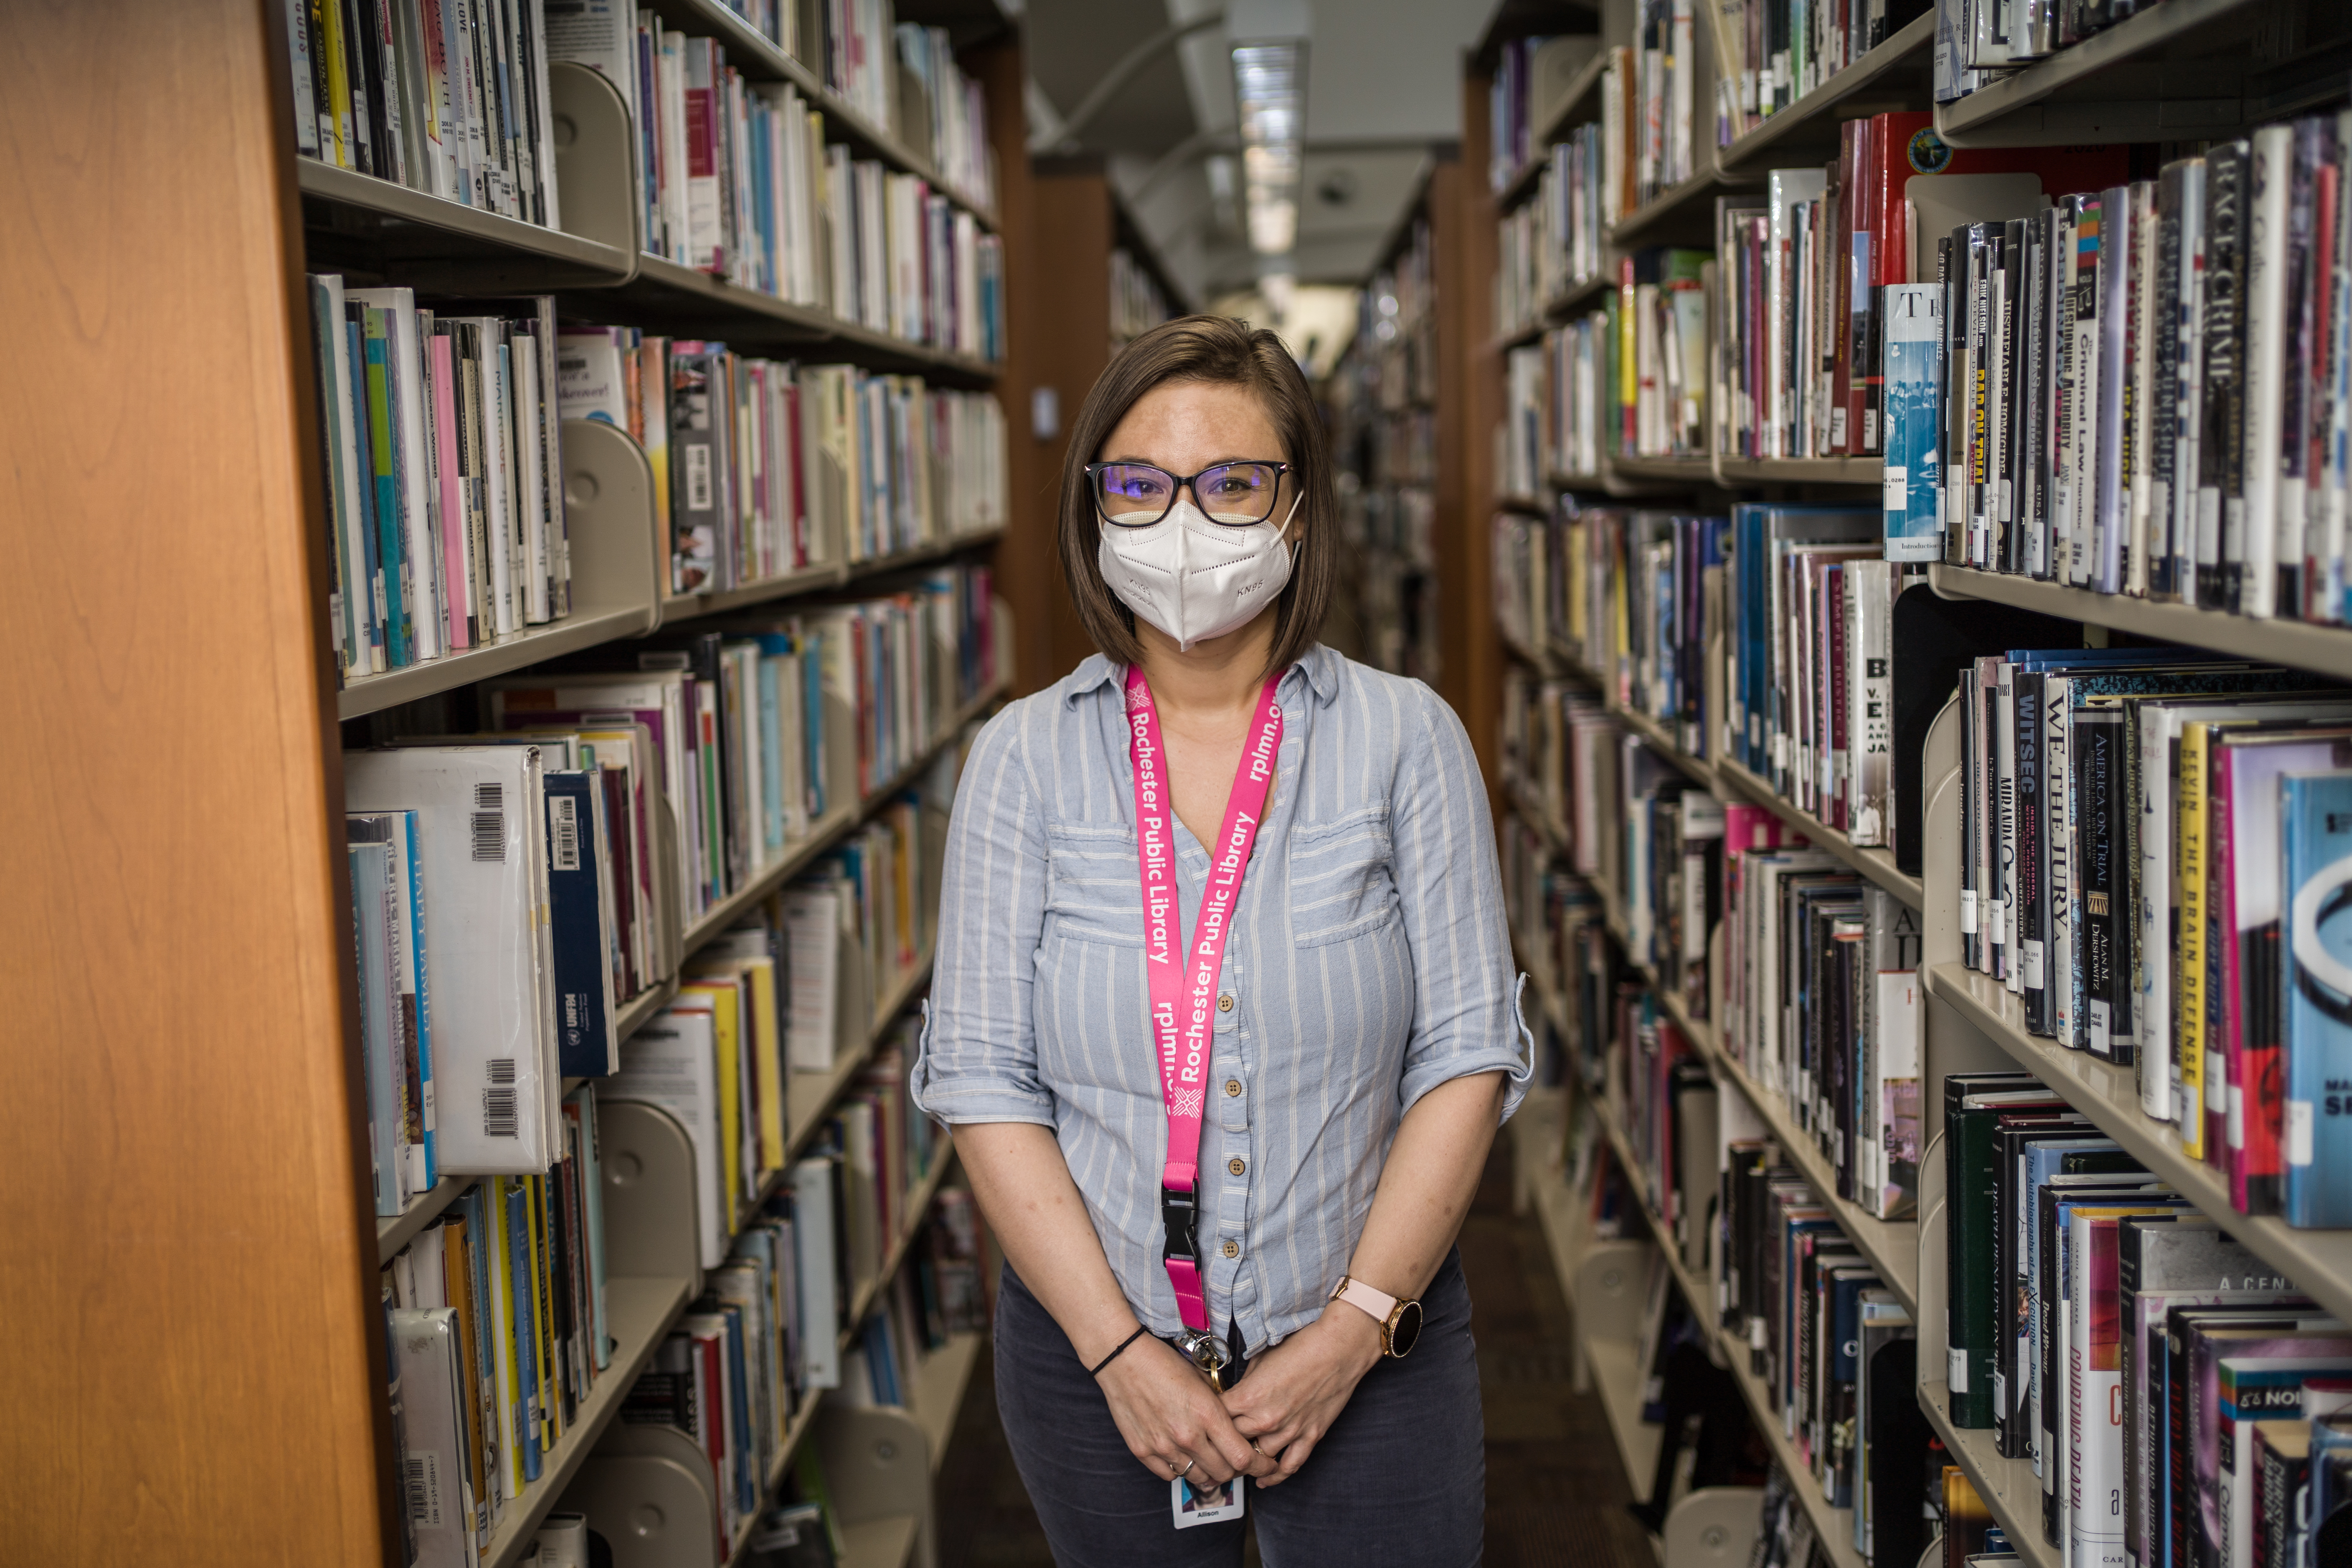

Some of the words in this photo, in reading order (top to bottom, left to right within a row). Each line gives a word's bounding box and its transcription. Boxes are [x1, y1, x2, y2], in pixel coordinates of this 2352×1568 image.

[458, 2, 467, 34] LOVE
[1938, 252, 1945, 263] 40
[2166, 218, 2179, 299] CRIME
[1978, 299, 1987, 333] NIELSON
[1979, 279, 1987, 297] ERIK
[2056, 241, 2066, 389] ORDINARY
[1937, 313, 1944, 327] 40
[2001, 299, 2011, 396] JUSTIFIABLE
[2163, 310, 2176, 352] AND
[1972, 345, 1976, 355] IN
[2078, 334, 2089, 422] Criminal
[495, 371, 505, 474] MARRIAGE
[1975, 409, 1984, 433] ON
[1999, 402, 2008, 473] HOMICIDE
[2061, 379, 2074, 448] AUTHORITY
[1975, 438, 1984, 484] TRIAL
[2078, 429, 2087, 472] Law
[1129, 579, 1150, 596] KN95
[1237, 579, 1264, 598] KN95
[2019, 694, 2035, 793] WITSEC
[2047, 690, 2066, 766] WE,
[1132, 712, 1158, 812] Rochester
[2095, 733, 2108, 806] AMERICA
[2187, 750, 2198, 811] KEVIN
[2000, 777, 2013, 840] MIRANDA
[2051, 767, 2063, 833] THE
[2096, 812, 2106, 830] ON
[386, 837, 395, 866] THE
[1144, 817, 1166, 881] Public
[1989, 824, 1993, 835] TO
[2186, 834, 2198, 876] THE
[2052, 836, 2068, 931] JURY
[2097, 840, 2108, 886] TRIAL
[415, 860, 426, 936] HAPPY
[1149, 885, 1169, 964] Library
[2185, 891, 2198, 962] BRAIN
[389, 873, 402, 982] FREE-MARKET
[1181, 961, 1213, 1083] Rochester
[1198, 889, 1230, 955] Public
[1215, 811, 1256, 885] Library
[2092, 923, 2100, 991] DERSHOWITZ
[2101, 967, 2109, 981] M.
[396, 995, 404, 1045] FAMILY
[420, 948, 431, 1035] FAMILY
[565, 993, 577, 1028] UNFPA
[391, 1009, 400, 1066] FAMILIES
[2184, 976, 2197, 1079] DEFENSE
[402, 1090, 411, 1140] EICHNER
[2029, 1256, 2035, 1267] of
[2029, 1270, 2034, 1283] an
[2219, 1276, 2231, 1290] A
[2028, 1286, 2040, 1346] EXECUTION
[2070, 1345, 2082, 1443] COURTING
[2123, 1410, 2129, 1424] OF
[429, 1455, 438, 1506] 0-19-520844-7
[2070, 1449, 2081, 1510] DEATH
[1197, 1510, 1220, 1519] Allison
